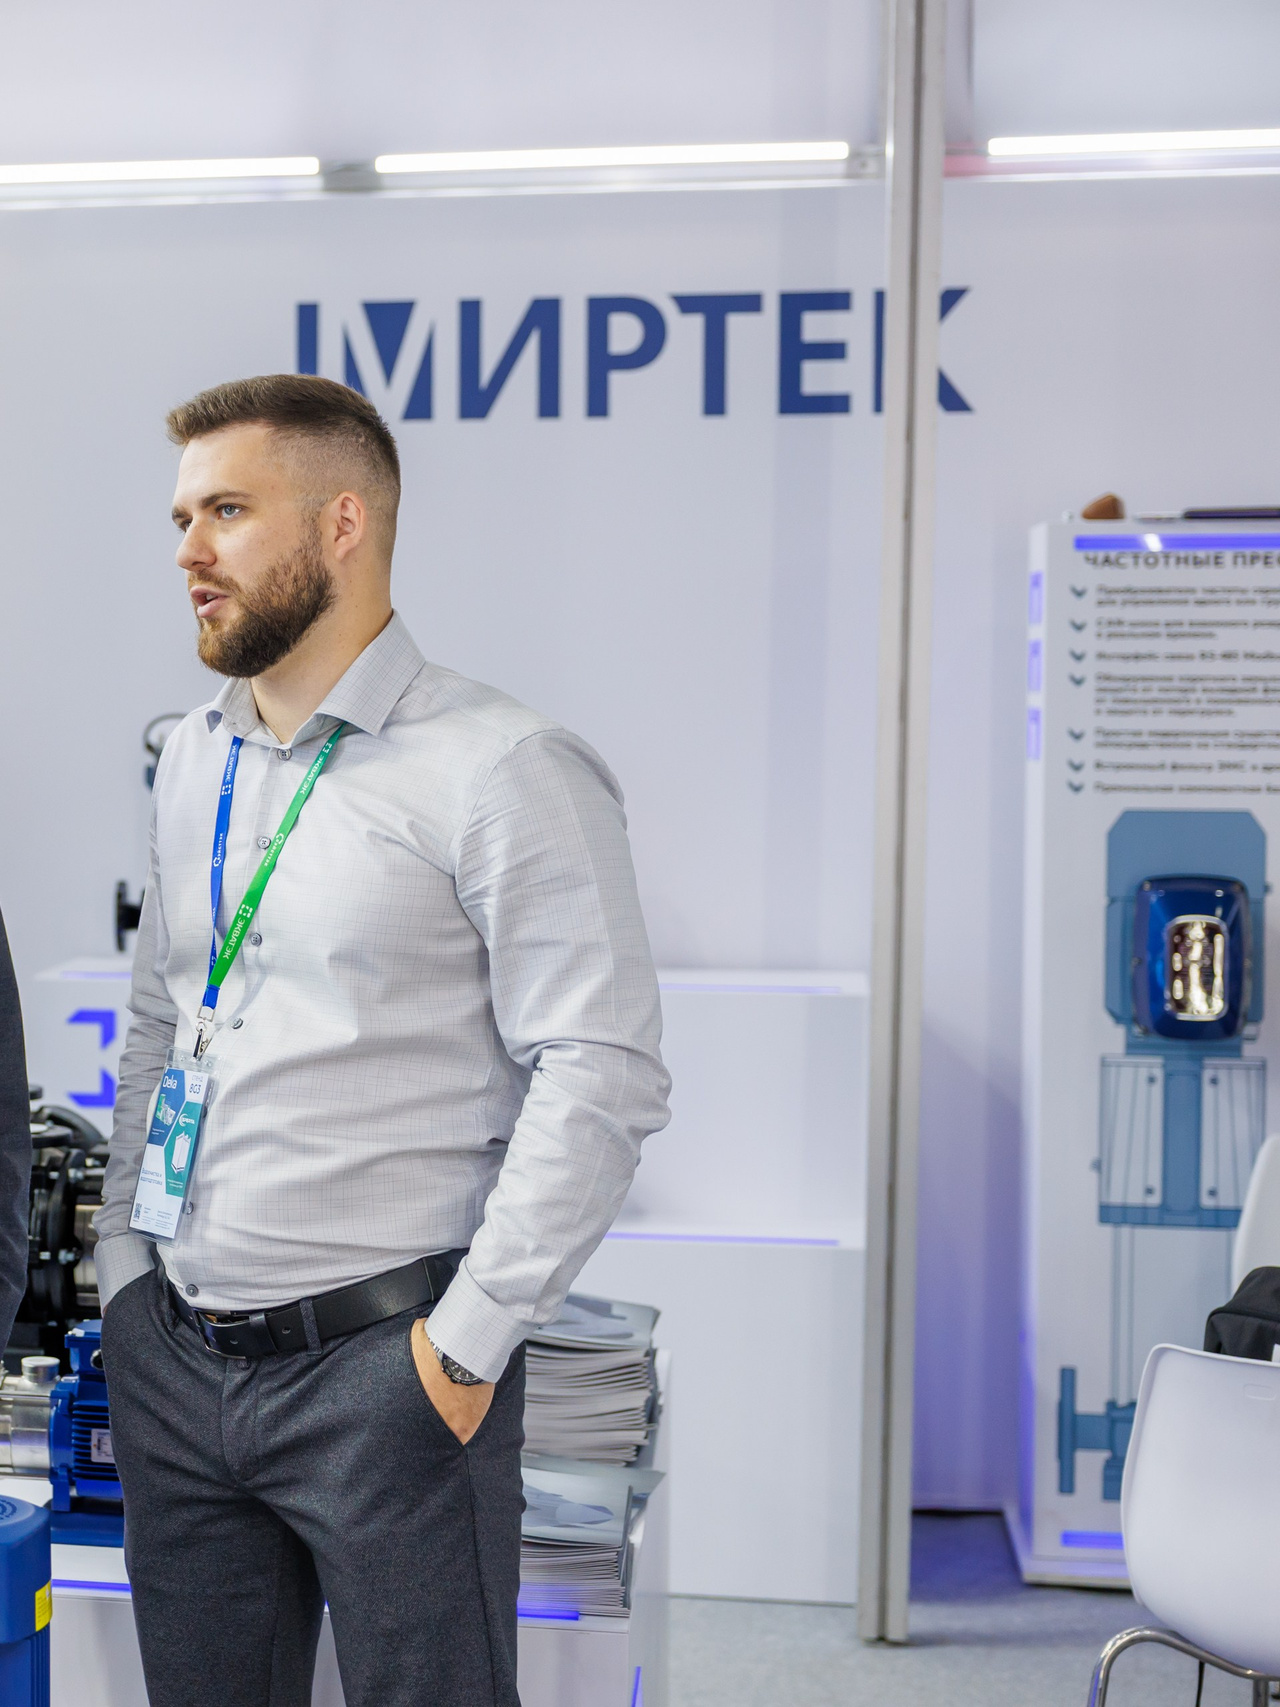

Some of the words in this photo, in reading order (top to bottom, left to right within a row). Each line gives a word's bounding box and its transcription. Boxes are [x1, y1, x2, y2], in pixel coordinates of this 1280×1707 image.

[1084, 552, 1225, 569] ЧАСТОТНЫЕ
[1232, 552, 1280, 569] ПРЕ
[300, 755, 324, 795] ЭКВАТЭК
[222, 917, 246, 960] ЭКВАТЭК
